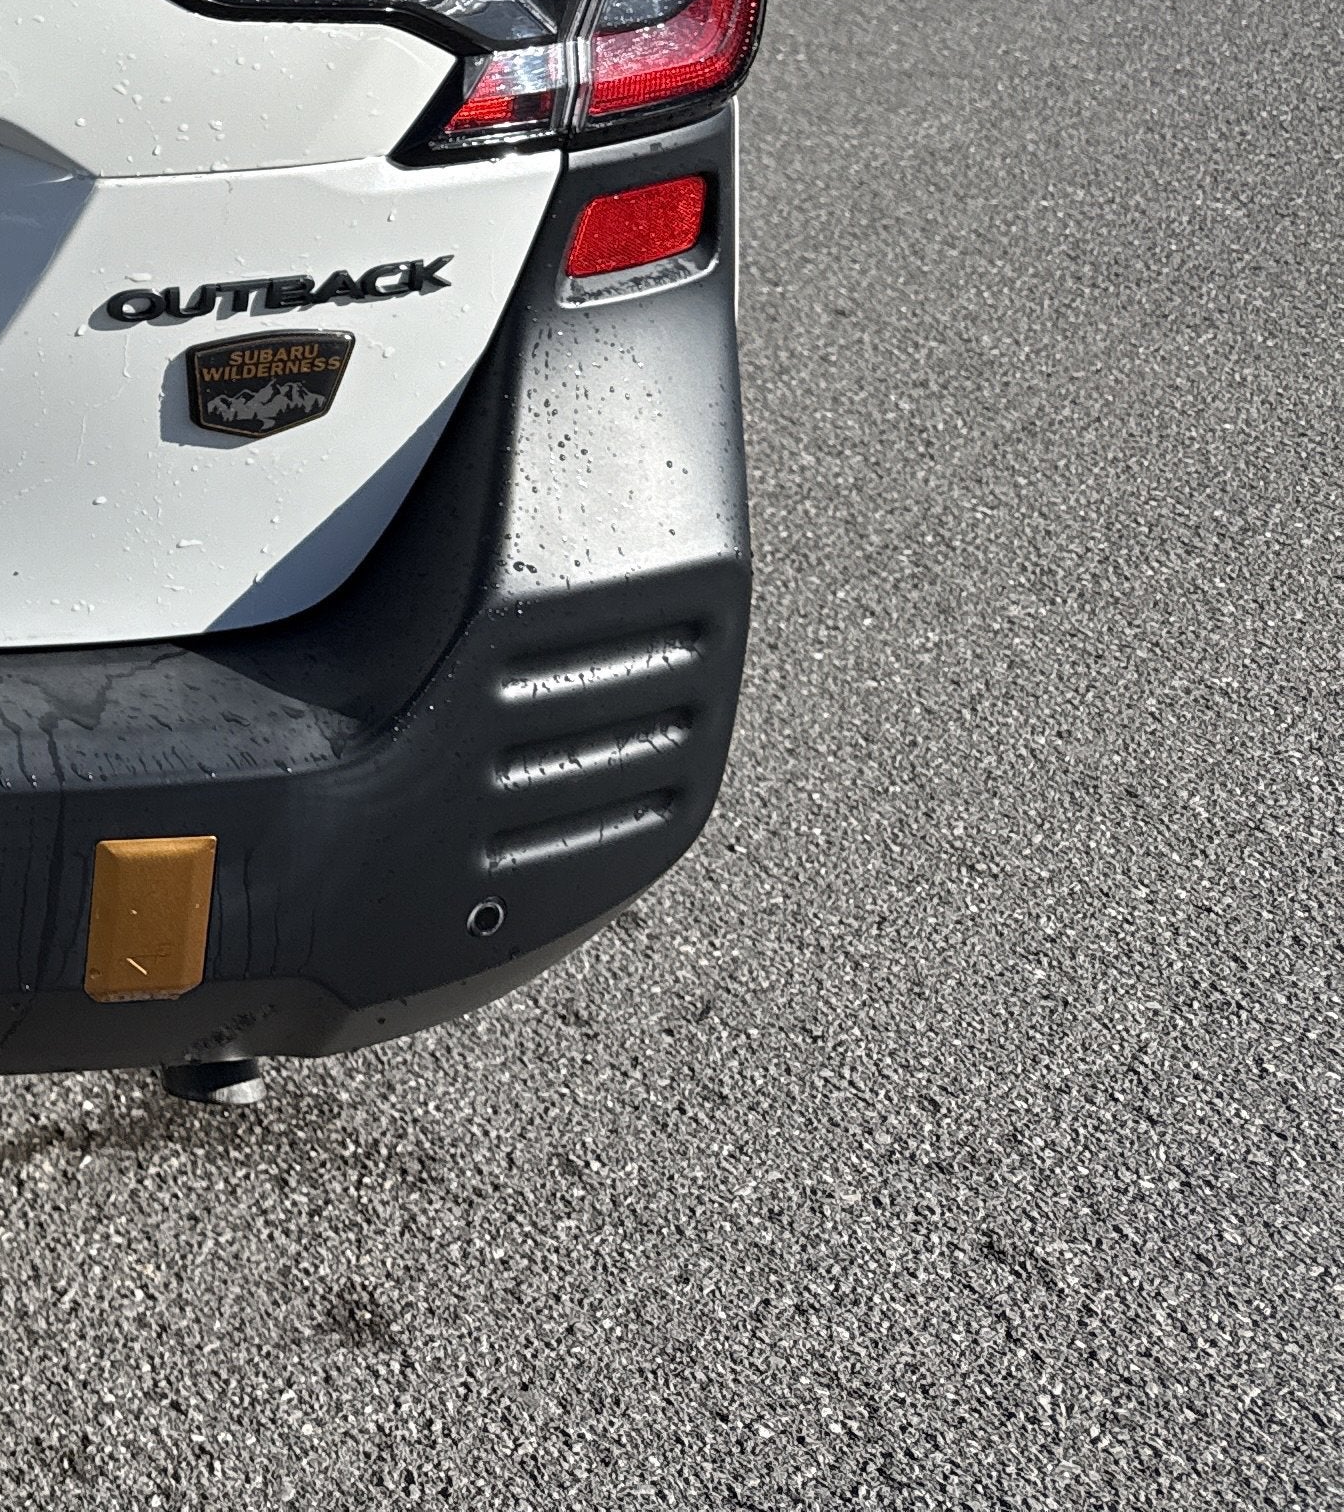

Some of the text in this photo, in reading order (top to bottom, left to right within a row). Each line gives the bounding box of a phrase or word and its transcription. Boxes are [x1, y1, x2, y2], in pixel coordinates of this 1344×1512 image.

[107, 254, 455, 323] OUTBACK
[201, 355, 342, 382] WILDERNESS
[228, 343, 319, 367] SUBARU
